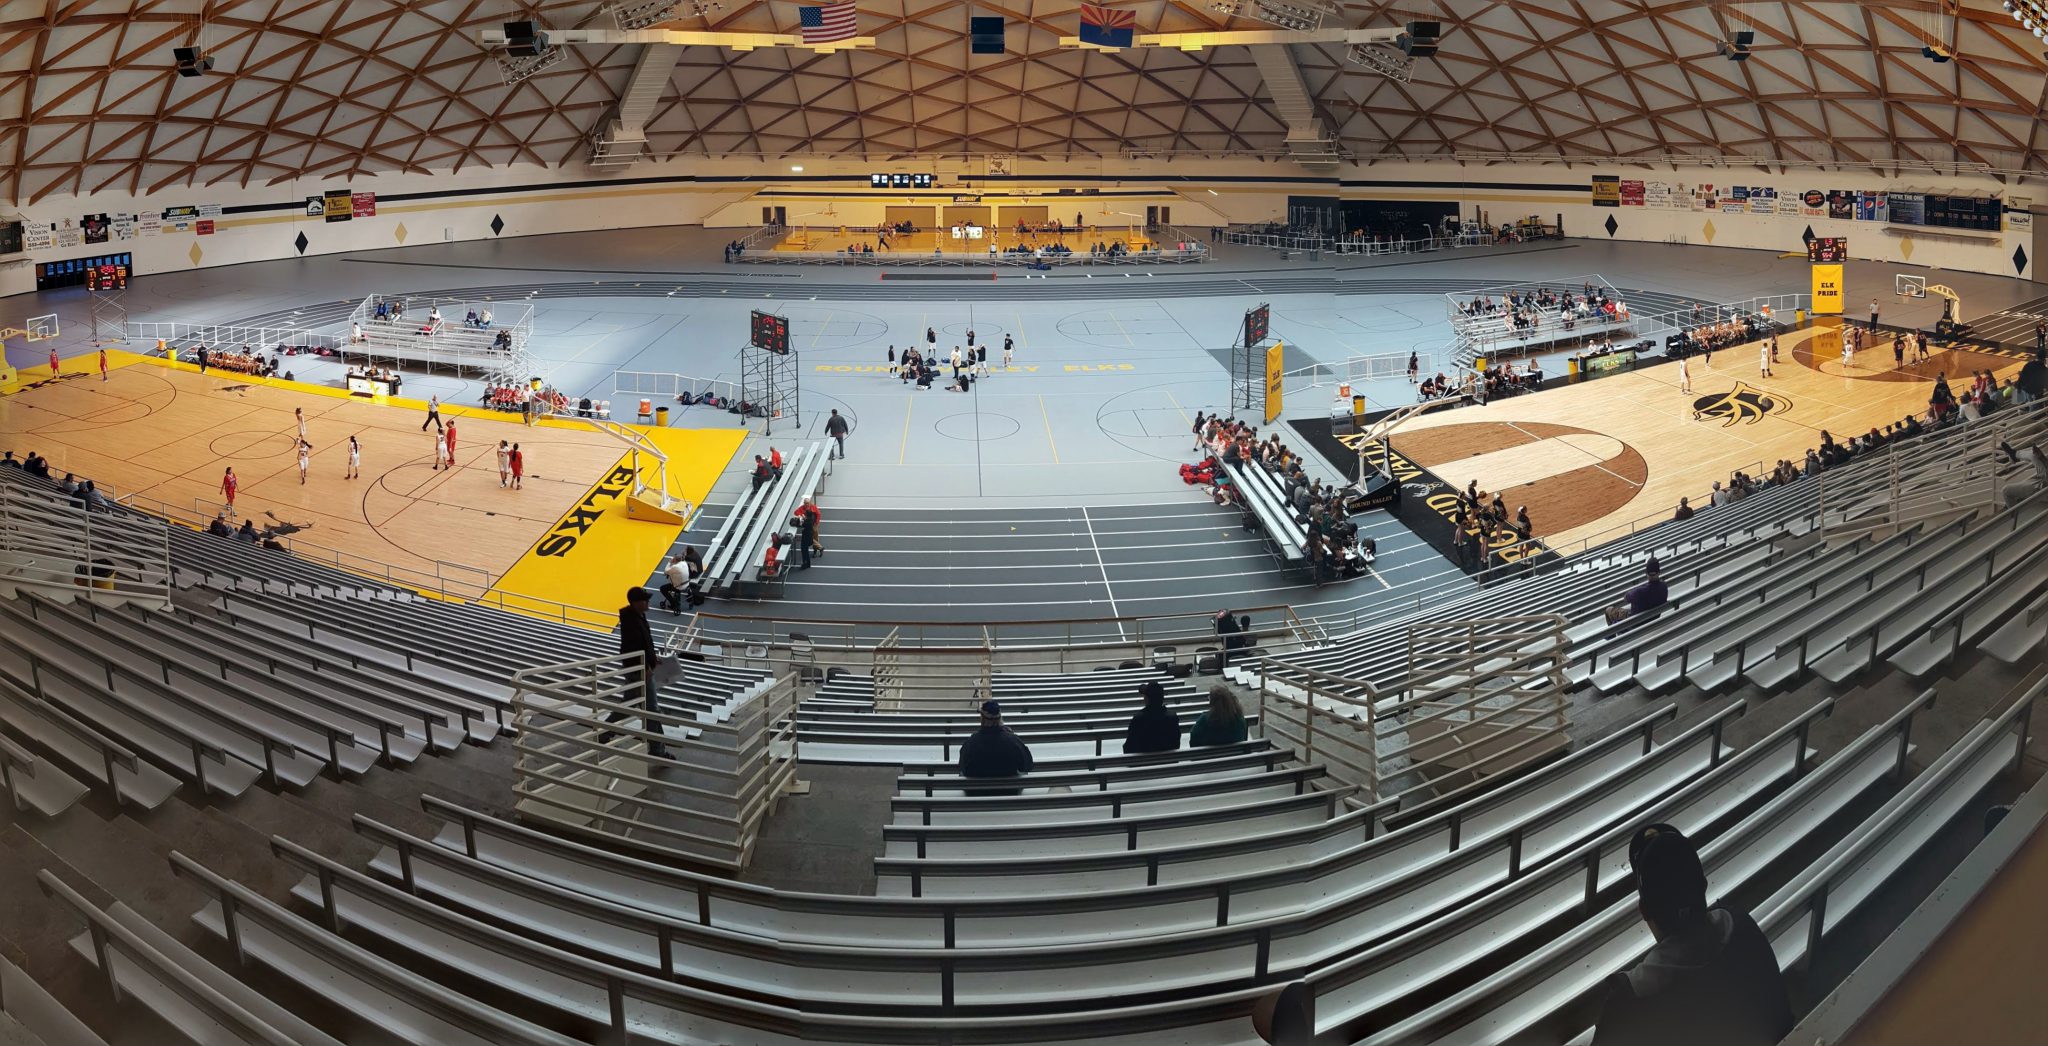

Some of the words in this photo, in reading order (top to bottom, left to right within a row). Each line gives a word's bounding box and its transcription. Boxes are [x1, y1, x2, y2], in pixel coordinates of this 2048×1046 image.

[139, 211, 160, 221] frontier
[169, 207, 193, 215] SUBWAY
[1063, 363, 1136, 373] ELKS
[1272, 370, 1281, 381] ELK
[1270, 380, 1282, 394] PRIDE
[1372, 495, 1393, 504] VALLEY
[535, 464, 644, 558] ELKS
